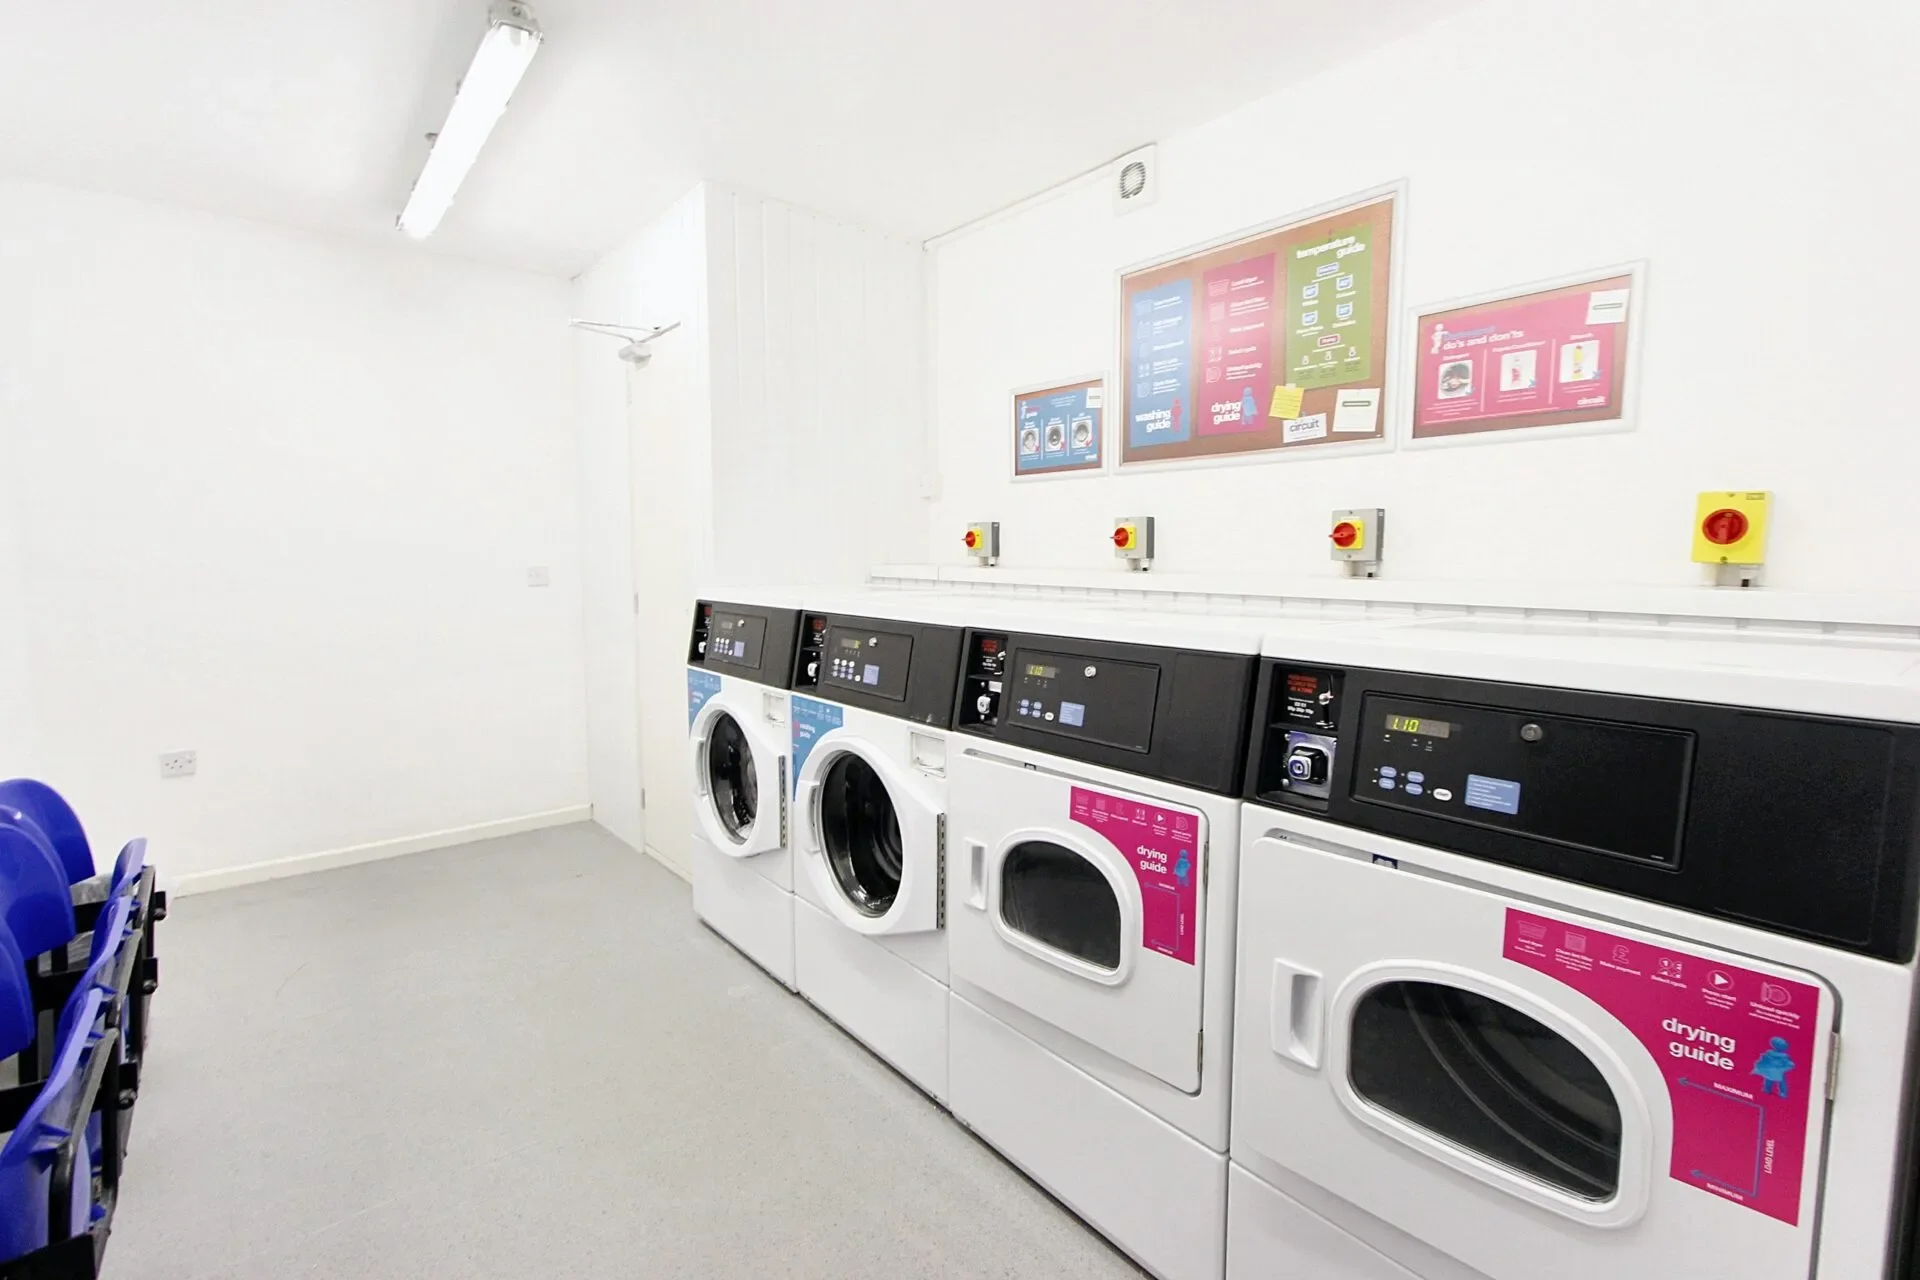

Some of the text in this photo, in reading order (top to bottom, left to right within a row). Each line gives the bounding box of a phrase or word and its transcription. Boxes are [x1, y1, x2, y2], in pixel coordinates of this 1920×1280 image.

[1296, 236, 1356, 258] temperature
[1336, 242, 1366, 259] guide
[1442, 338, 1466, 350] do's
[1467, 334, 1487, 346] and
[1488, 330, 1524, 343] don'ts
[1211, 400, 1242, 413] drying
[1135, 409, 1172, 422] washing
[1213, 412, 1241, 425] guide
[1146, 420, 1171, 433] guide
[1289, 418, 1320, 432] circuit
[1137, 845, 1168, 863] drying
[1140, 860, 1167, 874] guide
[1662, 1017, 1736, 1053] drying
[1668, 1041, 1735, 1071] guide
[1713, 1082, 1754, 1101] MAXIMUM
